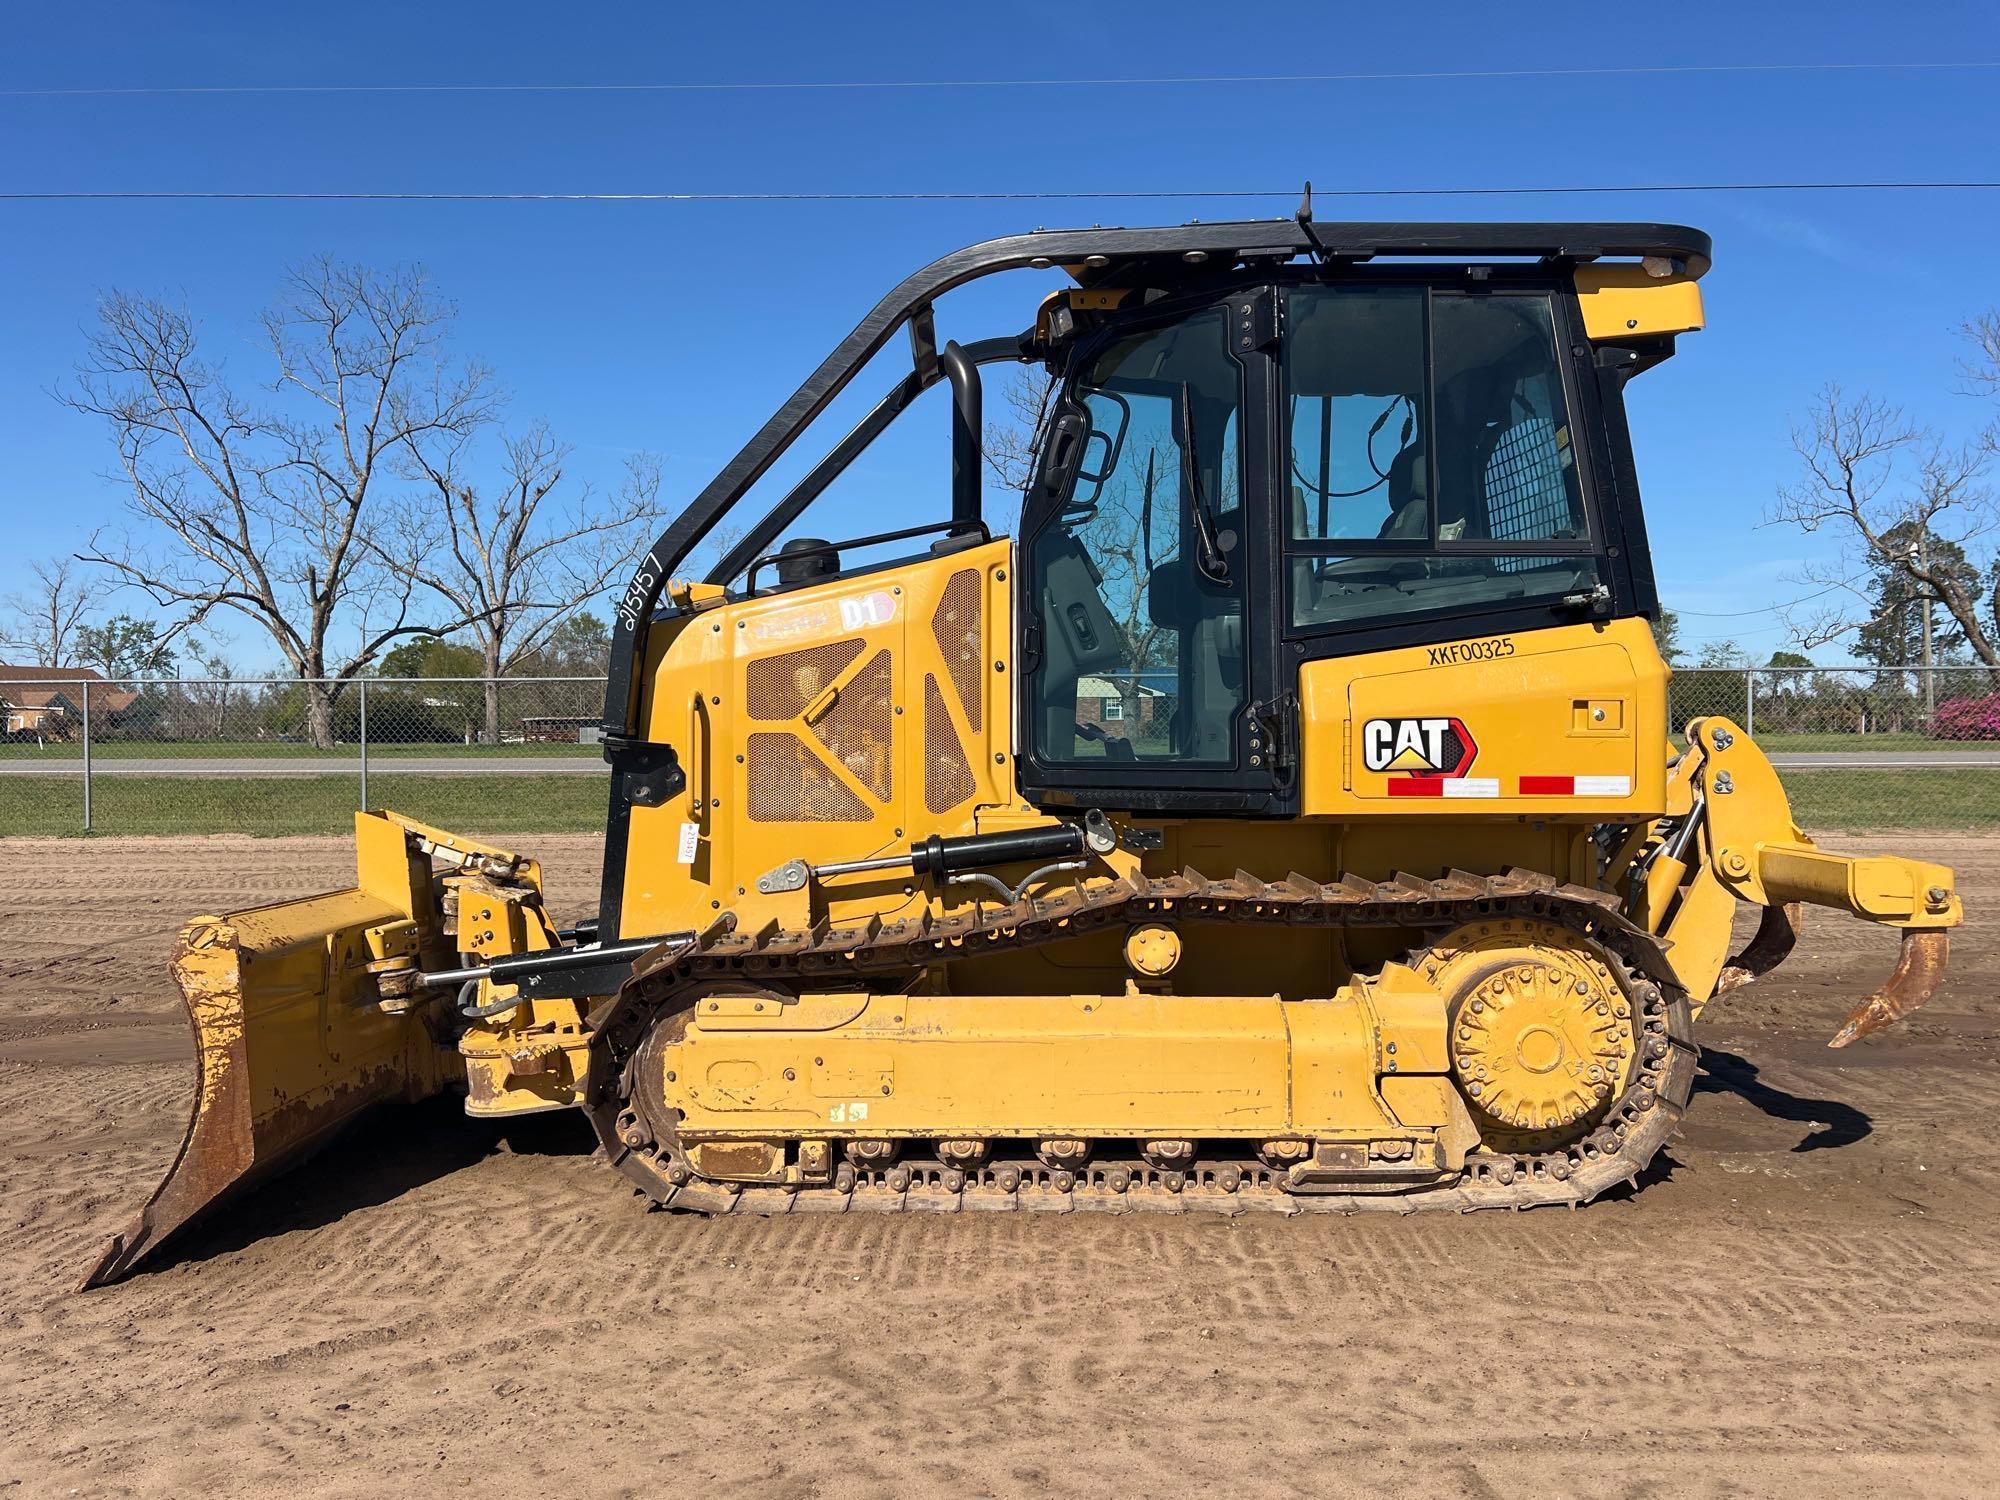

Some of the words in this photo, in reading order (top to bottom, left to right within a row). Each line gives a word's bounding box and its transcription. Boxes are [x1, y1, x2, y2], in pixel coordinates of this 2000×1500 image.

[619, 551, 663, 632] 215457
[840, 596, 877, 628] D1
[1427, 637, 1515, 665] XKF00325
[1365, 719, 1449, 770] CAT
